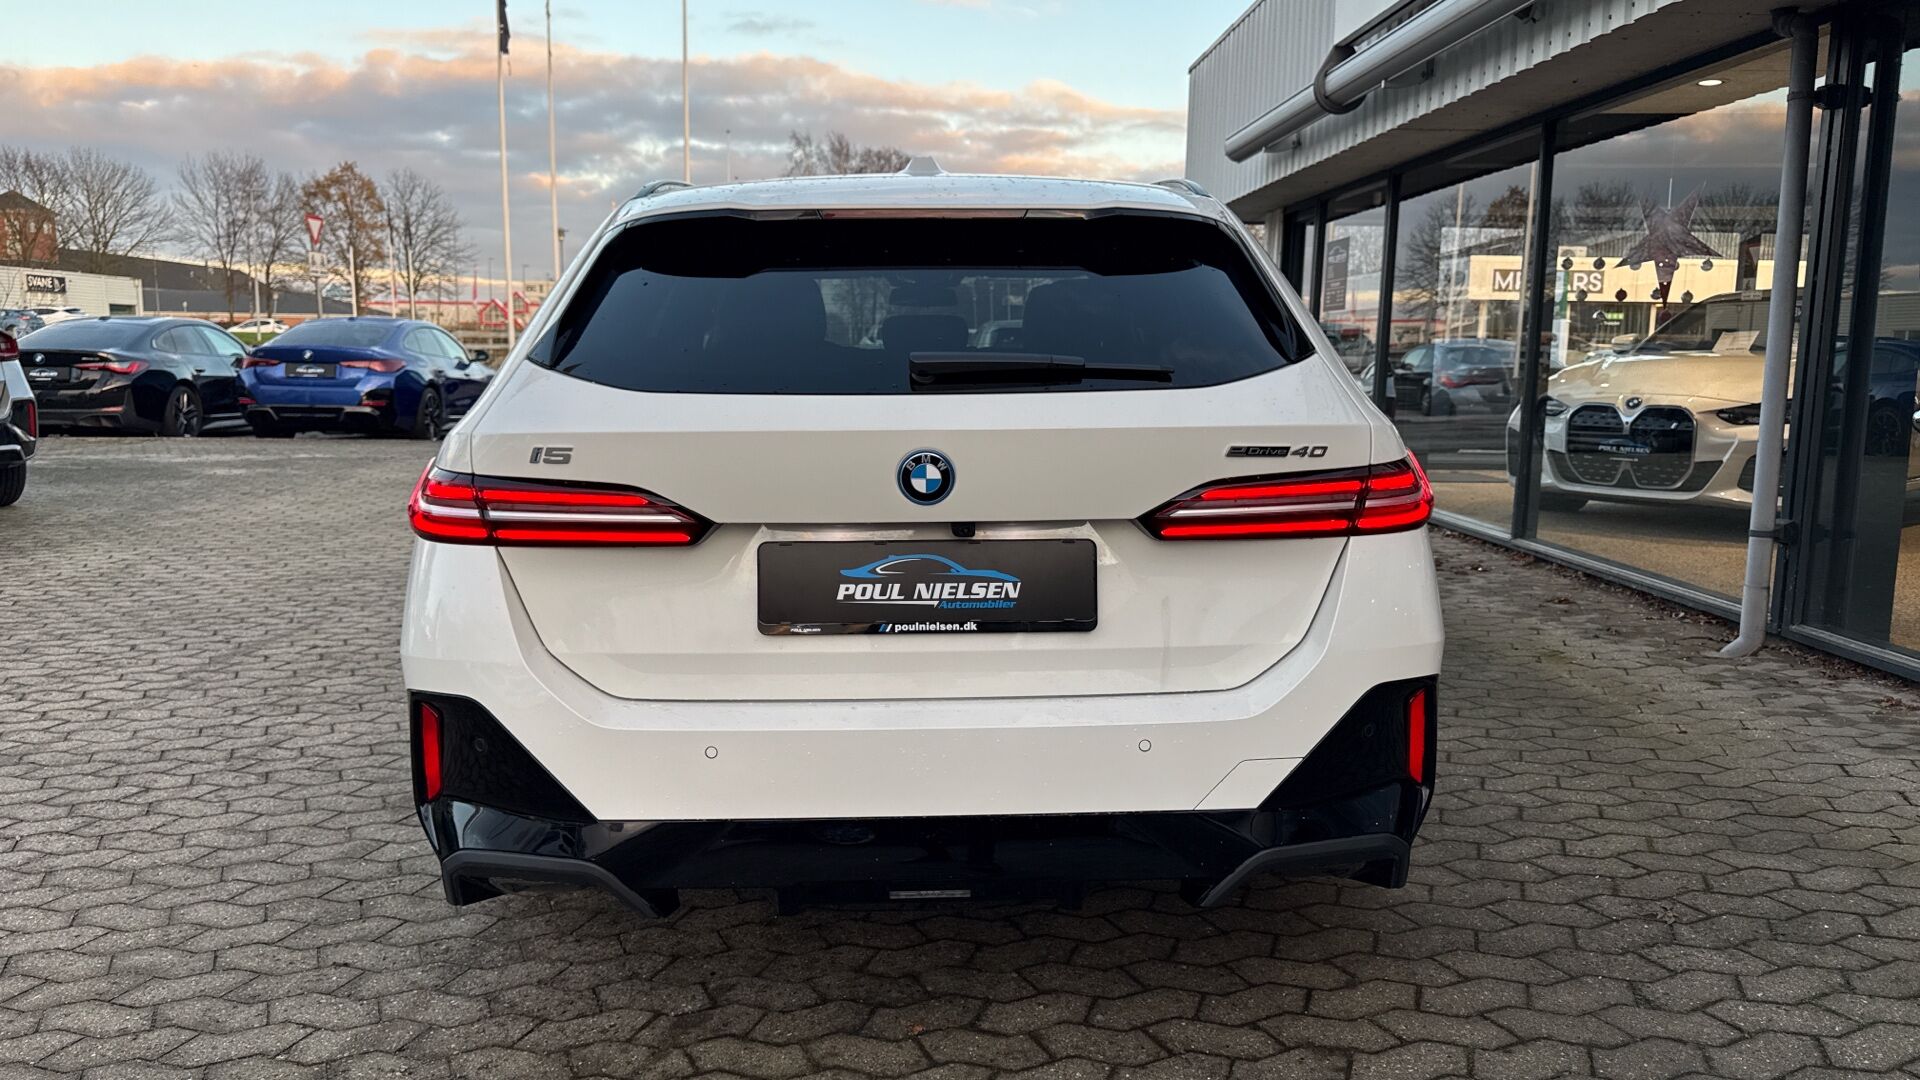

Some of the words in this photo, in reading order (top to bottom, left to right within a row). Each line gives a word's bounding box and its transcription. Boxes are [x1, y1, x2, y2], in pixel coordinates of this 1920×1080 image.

[1290, 446, 1329, 457] 40
[906, 454, 948, 471] BMW
[836, 583, 905, 600] POUL
[913, 582, 1021, 599] NIELSEN
[938, 600, 1017, 609] Automobiler
[894, 621, 978, 633] poulnielsen.dk
